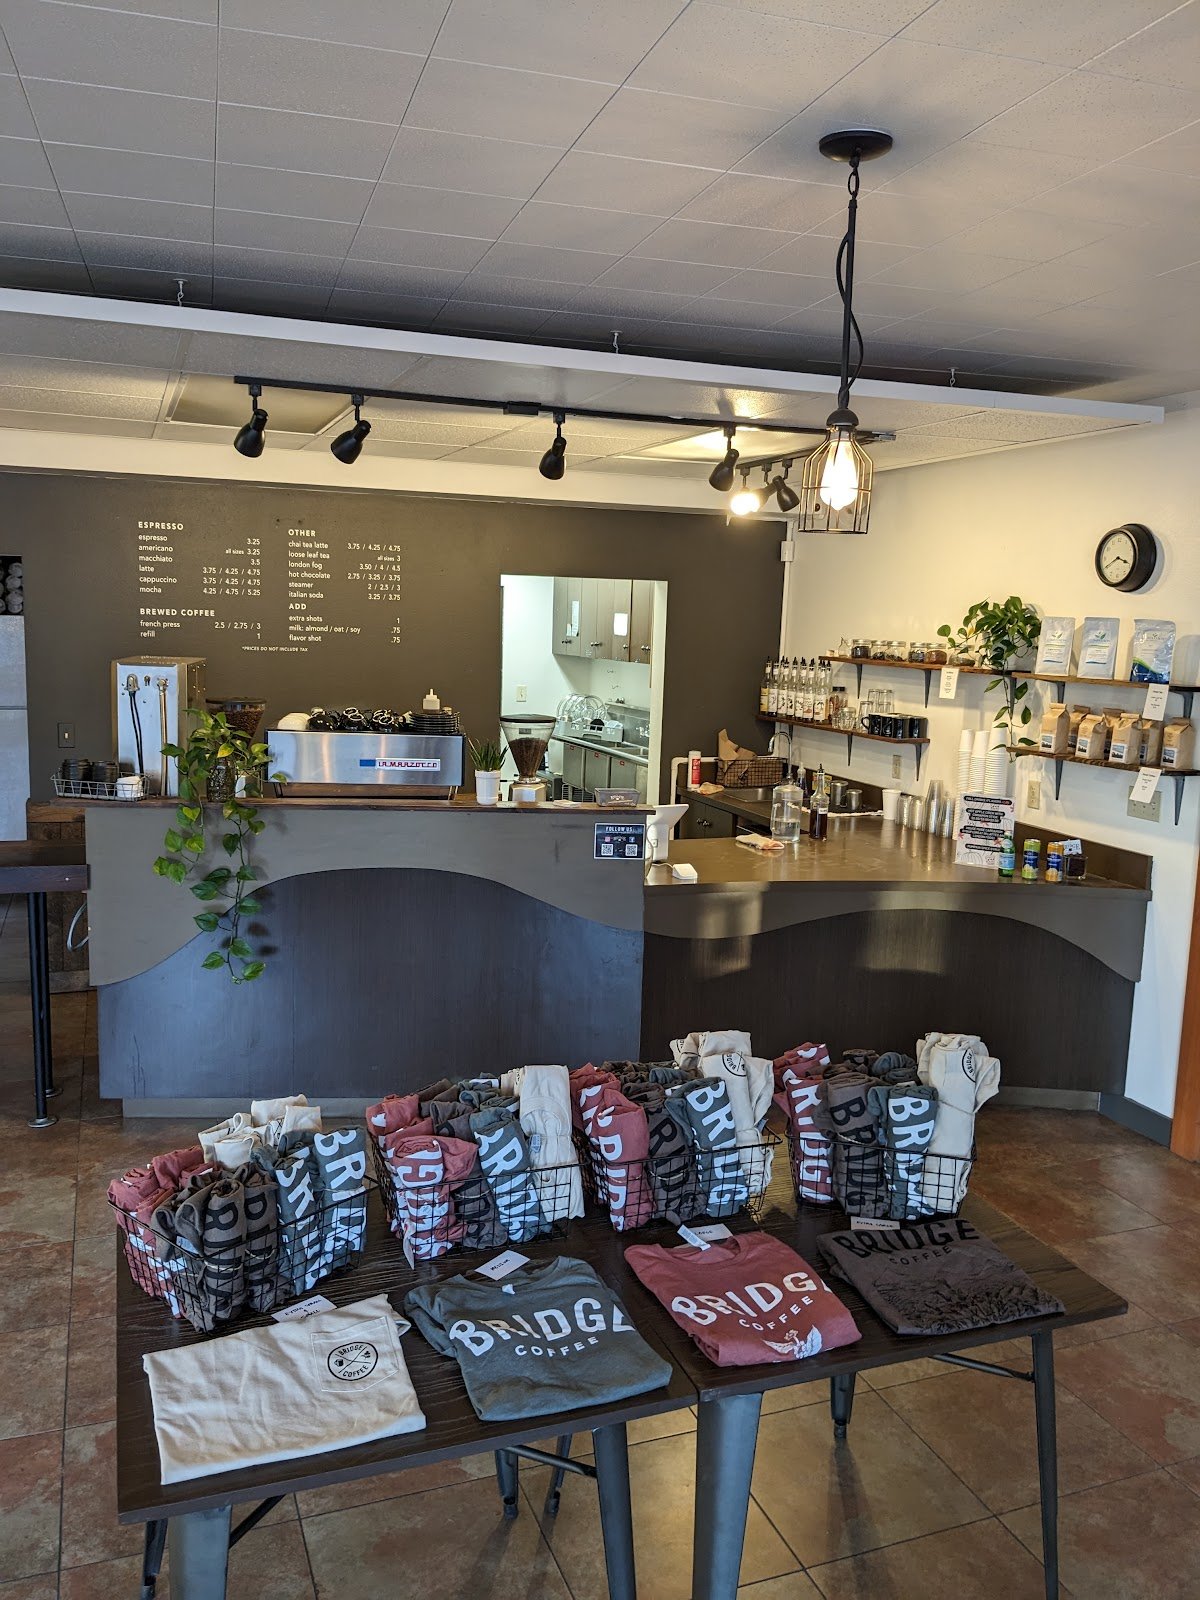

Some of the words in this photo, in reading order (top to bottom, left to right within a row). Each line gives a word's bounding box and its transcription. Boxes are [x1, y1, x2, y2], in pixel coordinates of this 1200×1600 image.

[138, 521, 184, 530] ESPRESSO
[288, 529, 316, 537] OTHER
[138, 544, 173, 552] americano
[314, 541, 328, 549] latte
[288, 550, 305, 558] loose
[139, 564, 154, 572] latte
[288, 560, 310, 568] london
[312, 561, 322, 570] fog
[300, 571, 331, 579] chocolate
[139, 576, 177, 584] cappuccino
[140, 608, 177, 616] BREWED
[181, 609, 215, 617] COFFEE
[215, 621, 225, 629] 2.5
[832, 1219, 980, 1258] BRIDGE
[889, 1245, 952, 1265] COFFEE
[738, 1295, 814, 1331] COFFEE
[338, 1344, 364, 1356] BRIDGE
[514, 1336, 599, 1357] COFFEE
[342, 1365, 369, 1378] COFFEE
